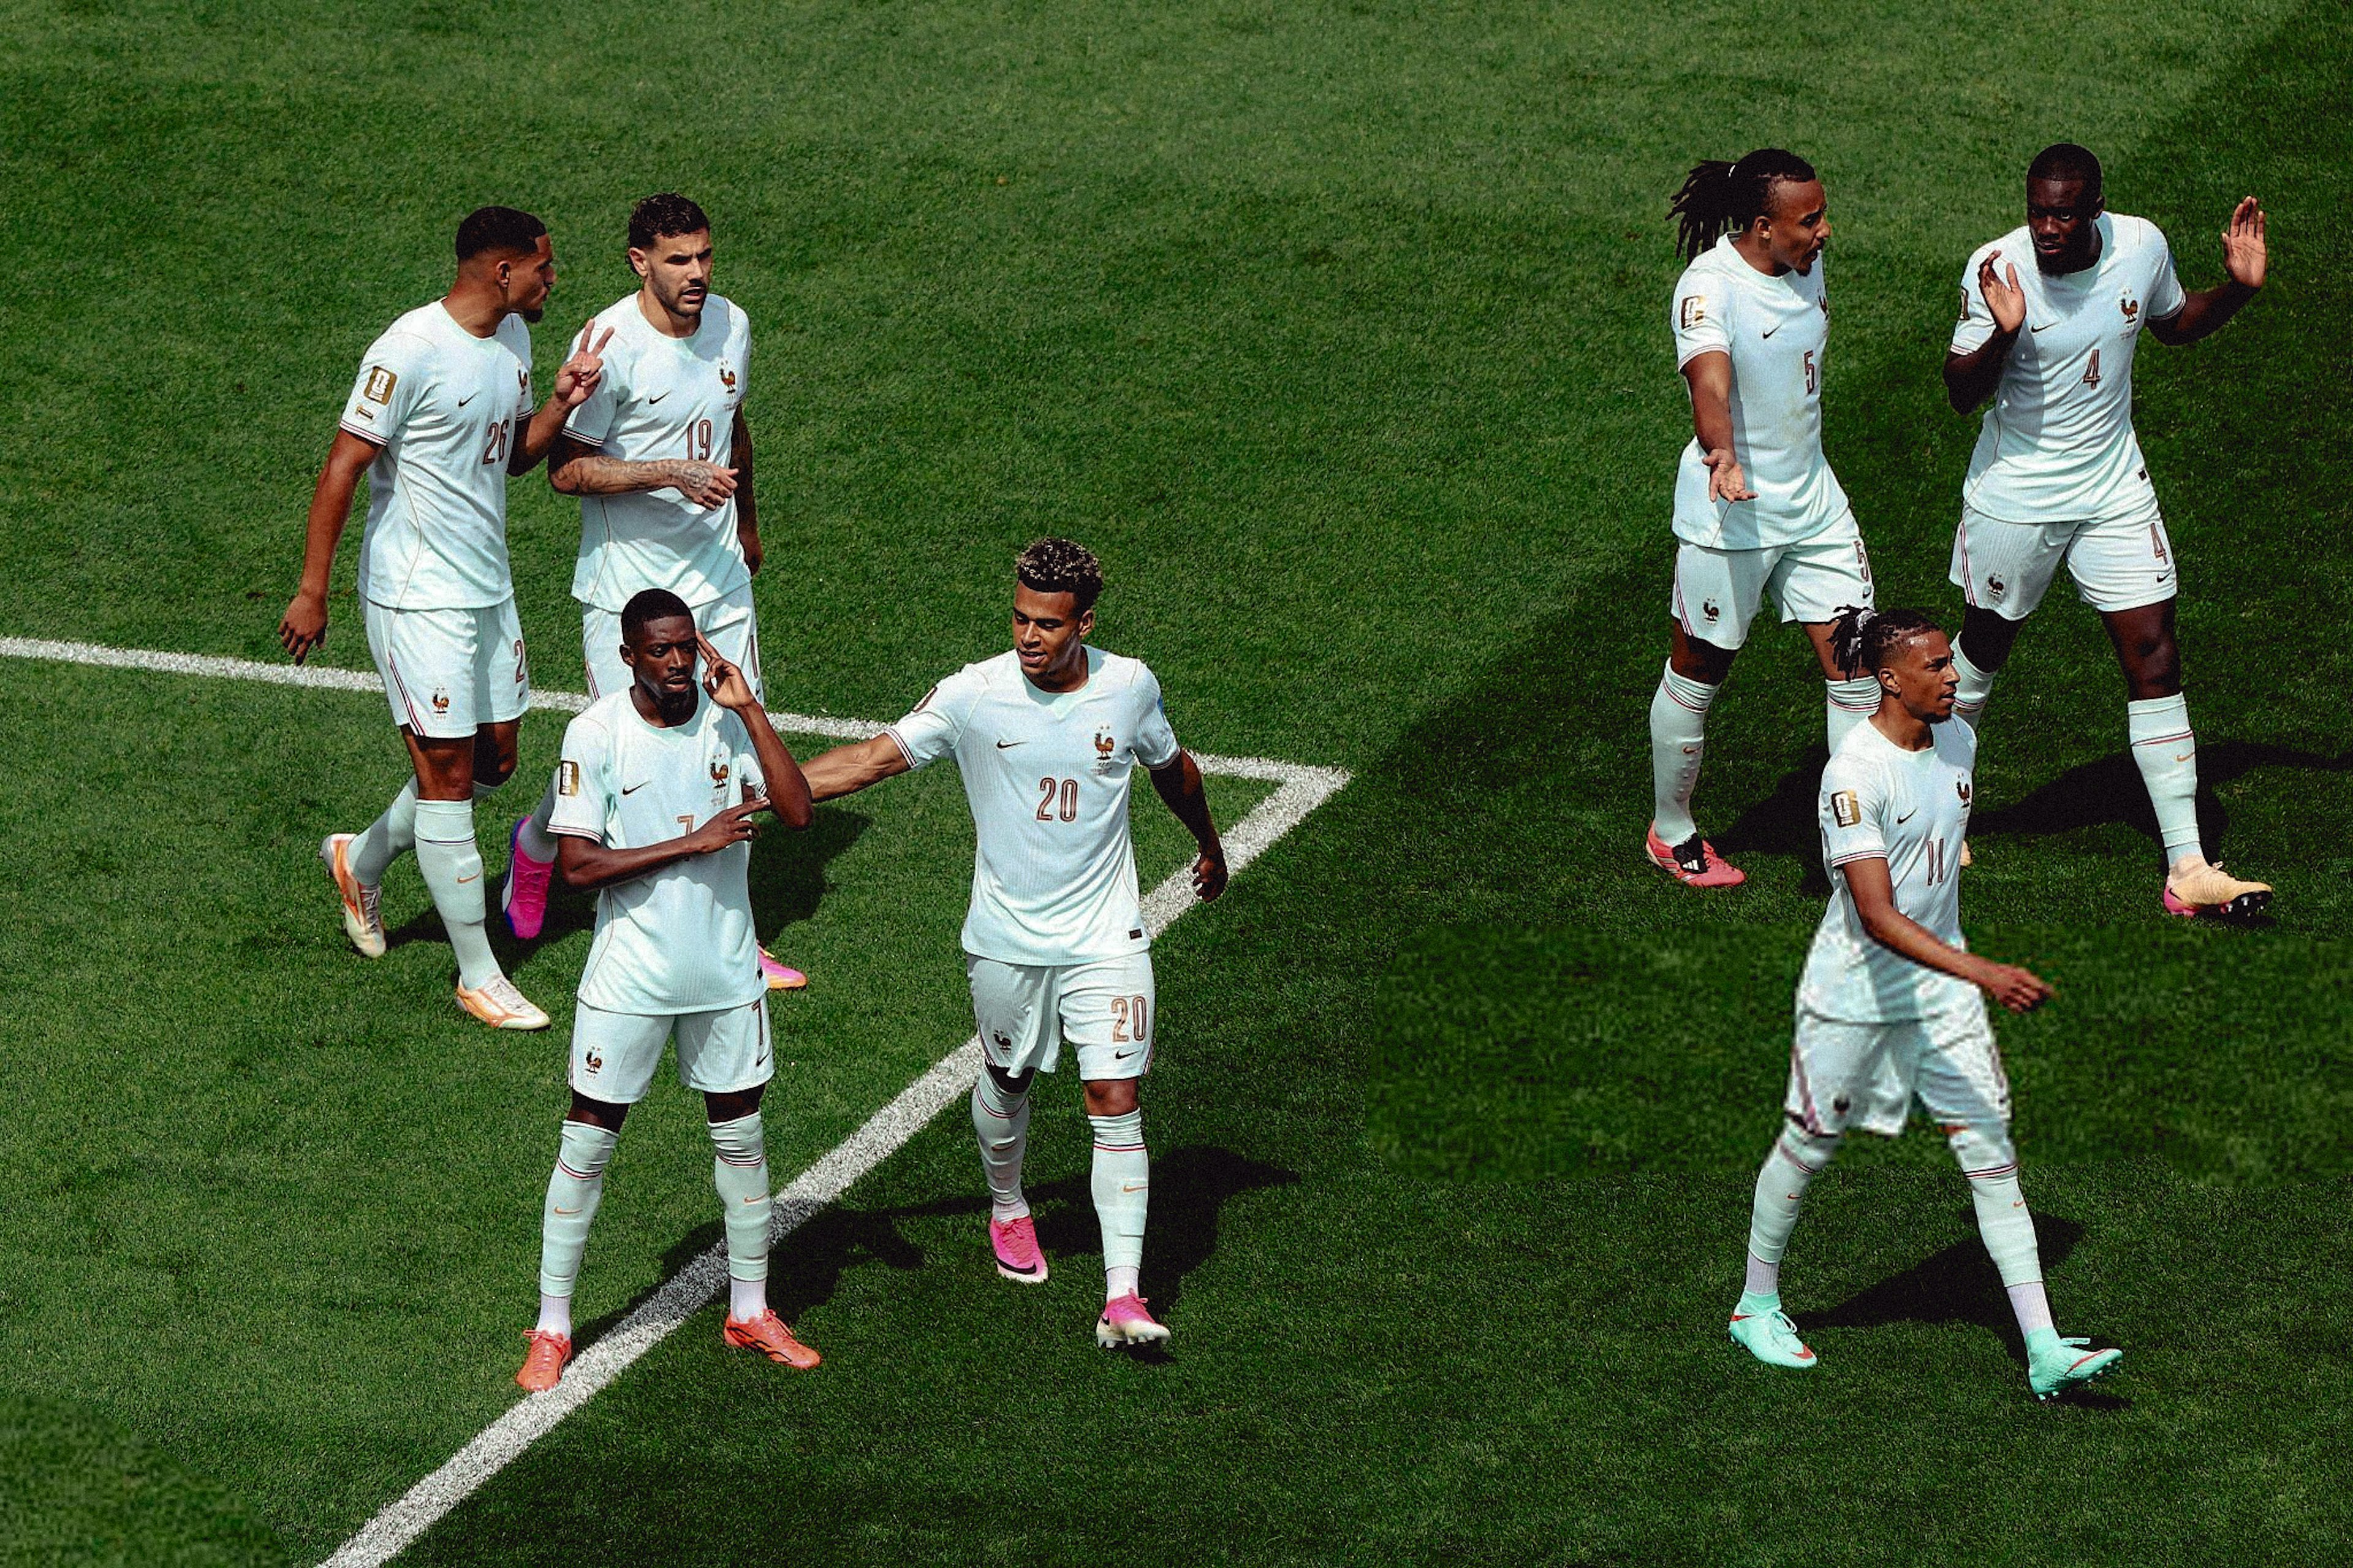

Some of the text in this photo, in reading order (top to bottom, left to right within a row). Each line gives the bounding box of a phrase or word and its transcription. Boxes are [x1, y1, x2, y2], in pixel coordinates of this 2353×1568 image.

[1803, 350, 1814, 395] 5
[2083, 349, 2100, 389] 4
[482, 419, 509, 464] 26
[687, 419, 711, 460] 19
[1854, 540, 1870, 582] 5
[2150, 523, 2167, 564] 4
[1037, 778, 1078, 822] 20
[1927, 838, 1944, 885] 11
[1111, 996, 1146, 1042] 20
